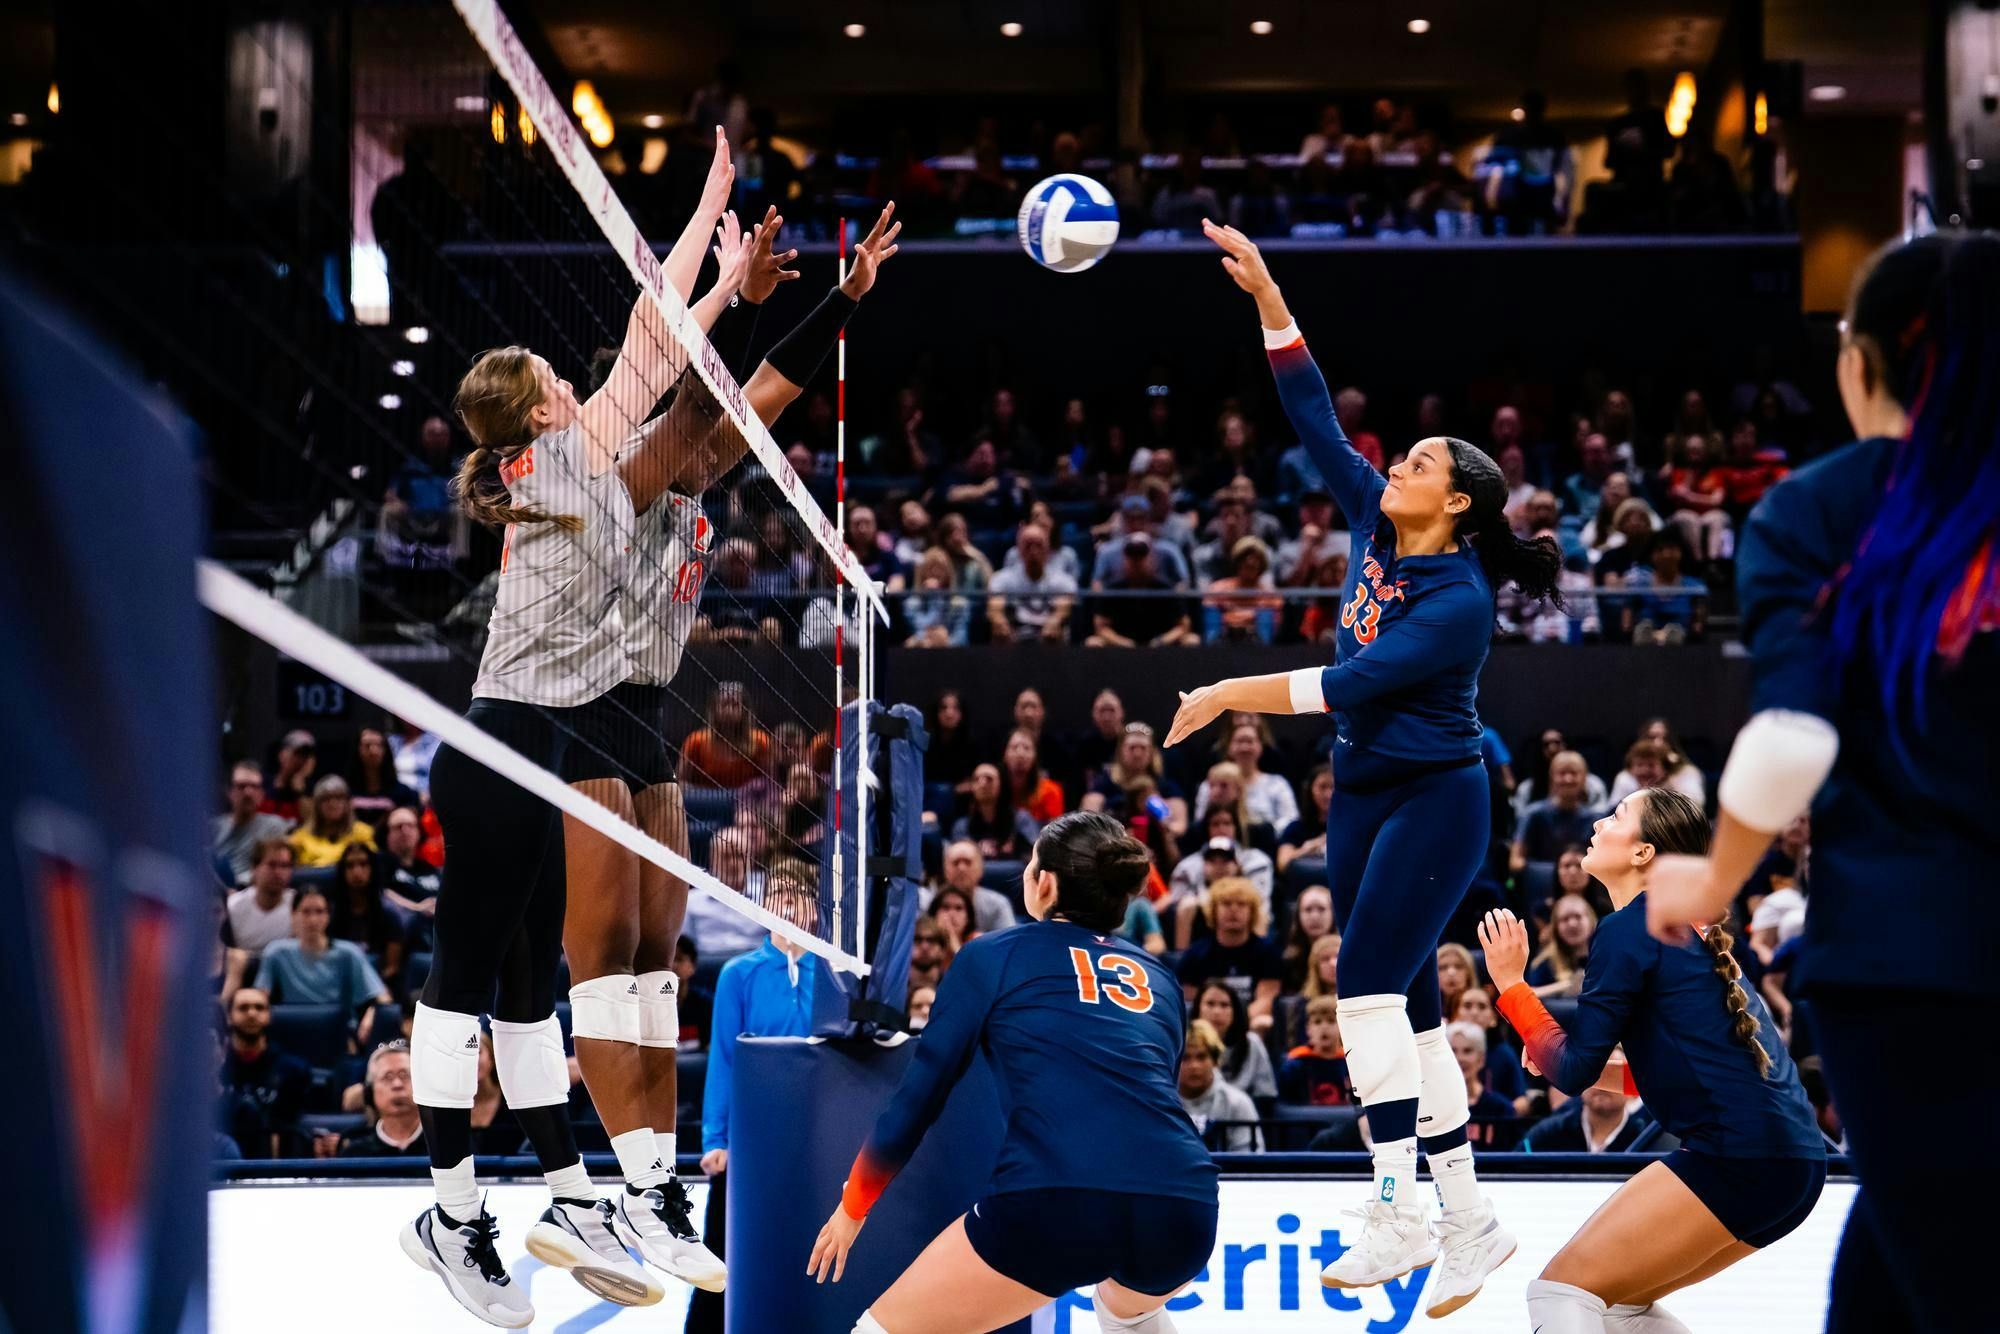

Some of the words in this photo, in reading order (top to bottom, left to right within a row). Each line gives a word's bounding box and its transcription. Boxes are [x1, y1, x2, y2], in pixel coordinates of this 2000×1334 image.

[1341, 582, 1382, 645] 33
[296, 683, 344, 714] 103
[1069, 947, 1154, 1014] 13
